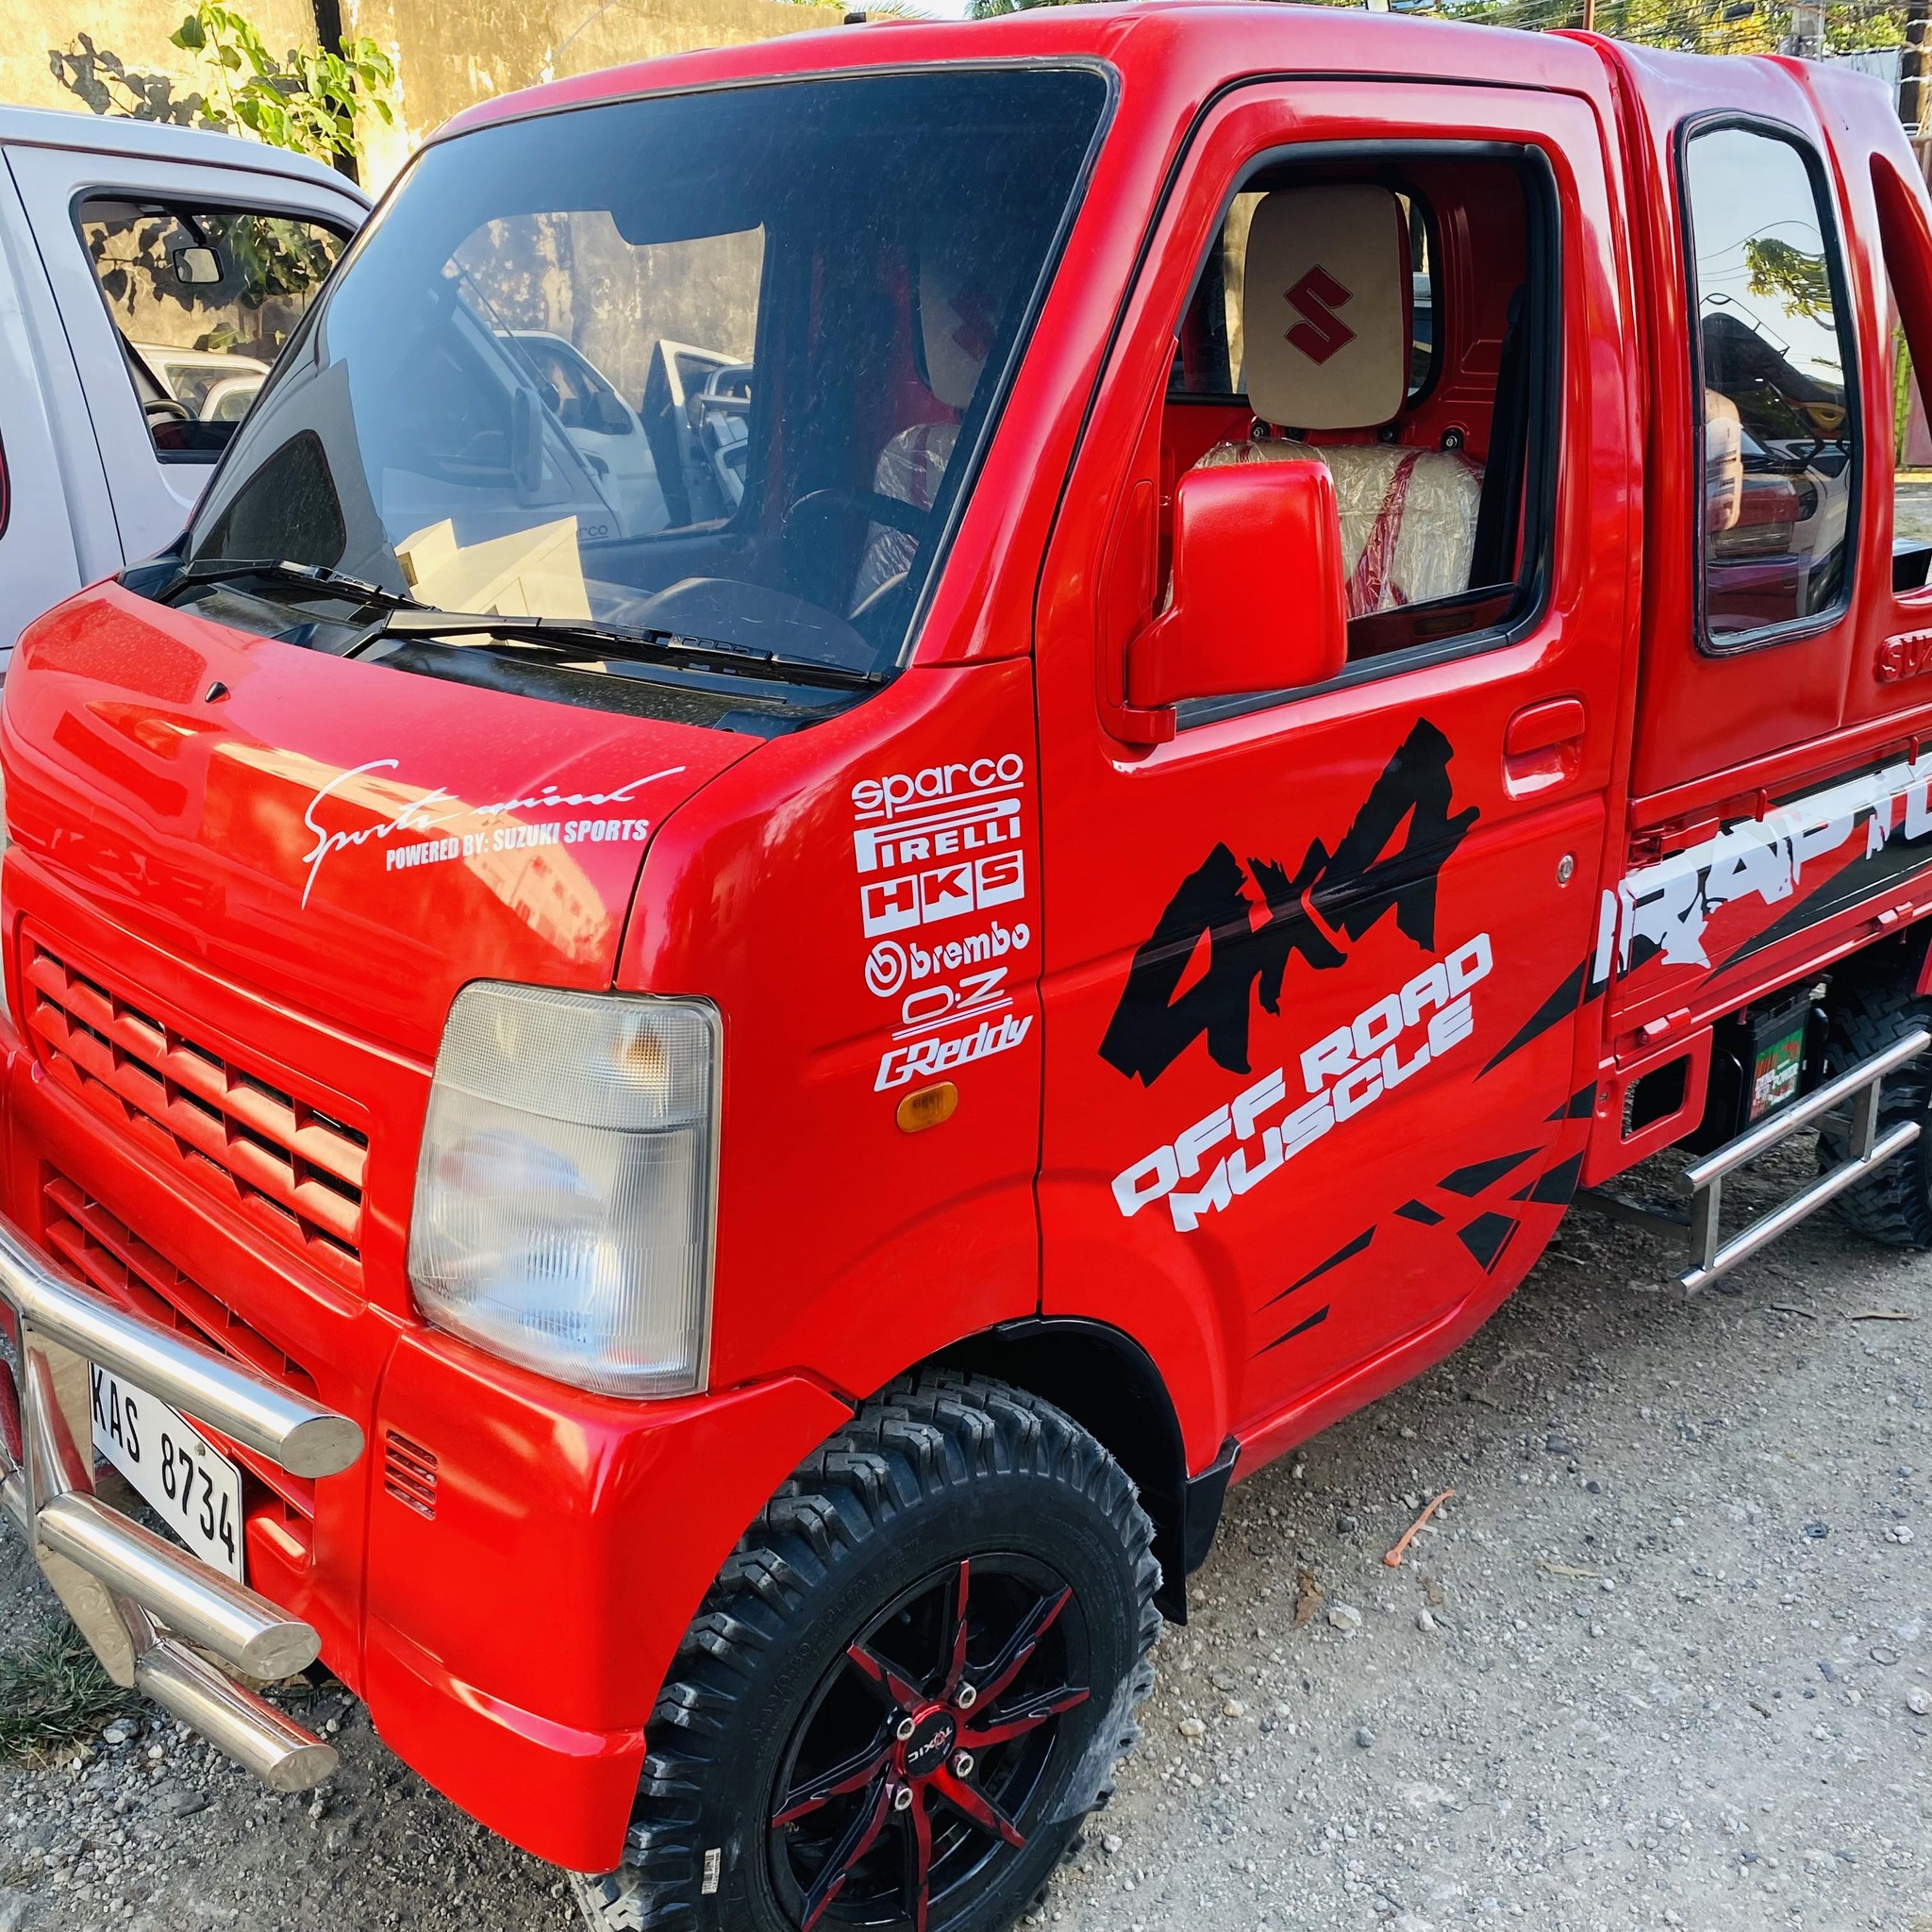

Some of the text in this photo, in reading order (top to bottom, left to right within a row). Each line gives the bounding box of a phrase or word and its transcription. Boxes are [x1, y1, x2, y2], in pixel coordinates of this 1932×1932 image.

[851, 753, 1024, 820] sparco
[386, 819, 650, 871] POWERED BY: SUZUKI SPORTS
[854, 798, 1021, 873] PIRELLI
[862, 851, 1023, 931] HKS
[909, 921, 1030, 980] brembo
[874, 1014, 1033, 1091] GReddy
[1111, 932, 1493, 1217] OFF ROAD
[1168, 991, 1474, 1232] MUSCLE
[91, 1361, 235, 1563] KAS 8734
